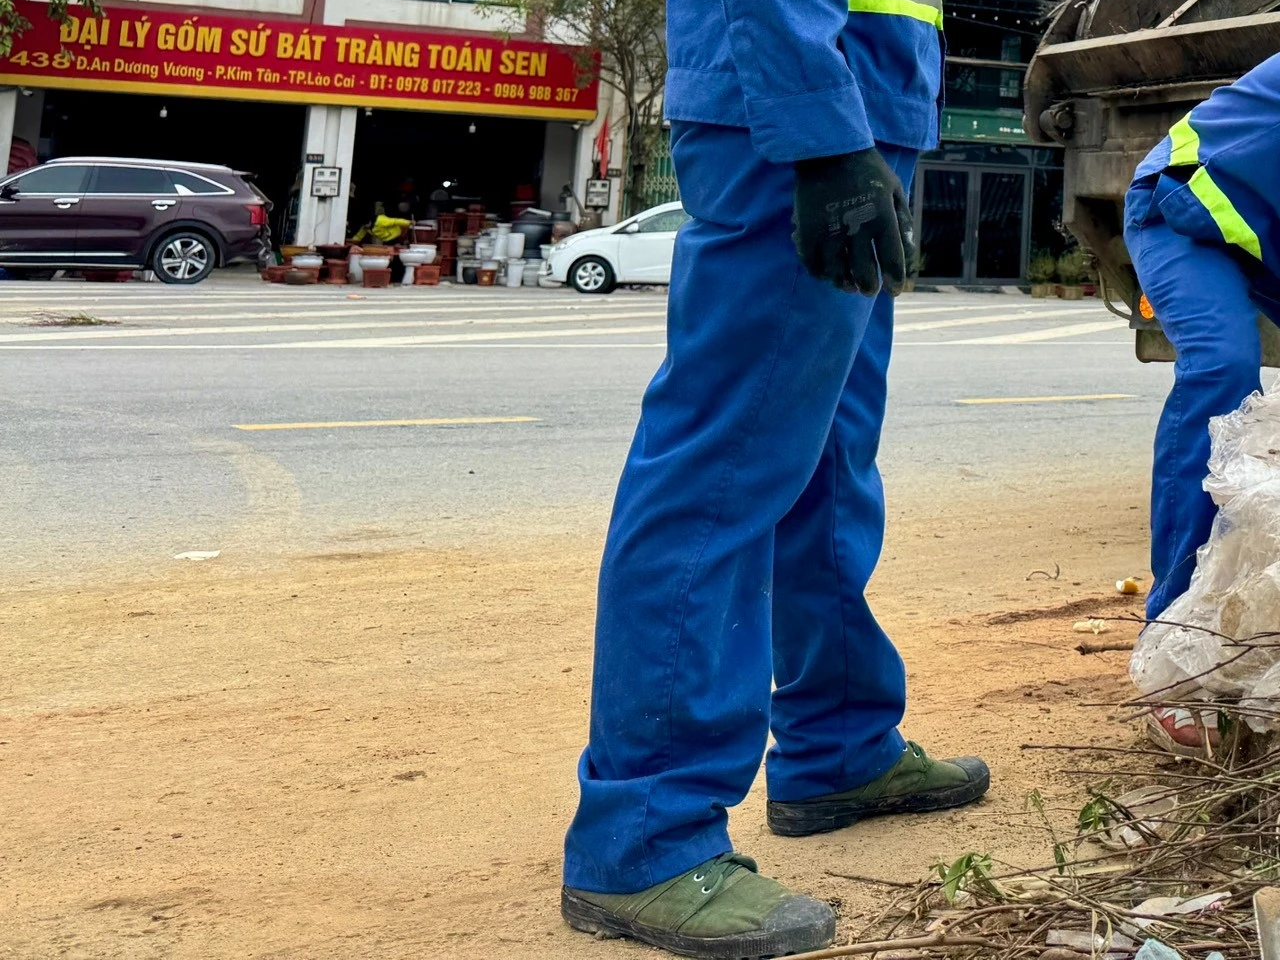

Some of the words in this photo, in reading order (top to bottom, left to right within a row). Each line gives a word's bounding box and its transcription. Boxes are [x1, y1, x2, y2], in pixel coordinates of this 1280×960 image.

[60, 16, 110, 50] ĐẠI
[119, 16, 151, 48] LÝ
[157, 16, 222, 53] GỐM
[230, 23, 272, 57] SỨ
[277, 29, 326, 61] BÁT
[336, 34, 420, 68] TRÀNG
[428, 42, 492, 73] TOÁN
[500, 50, 547, 77] SEN
[9, 50, 72, 69] 438
[114, 58, 159, 79] Dương
[164, 62, 204, 81] Vương
[216, 65, 252, 81] P.Kim
[257, 68, 280, 83] Tân
[334, 74, 355, 88] Cai
[396, 76, 428, 93] 0978
[432, 78, 455, 94] 017
[457, 80, 481, 96] 223
[494, 83, 525, 99] 0984
[555, 87, 579, 102] 367
